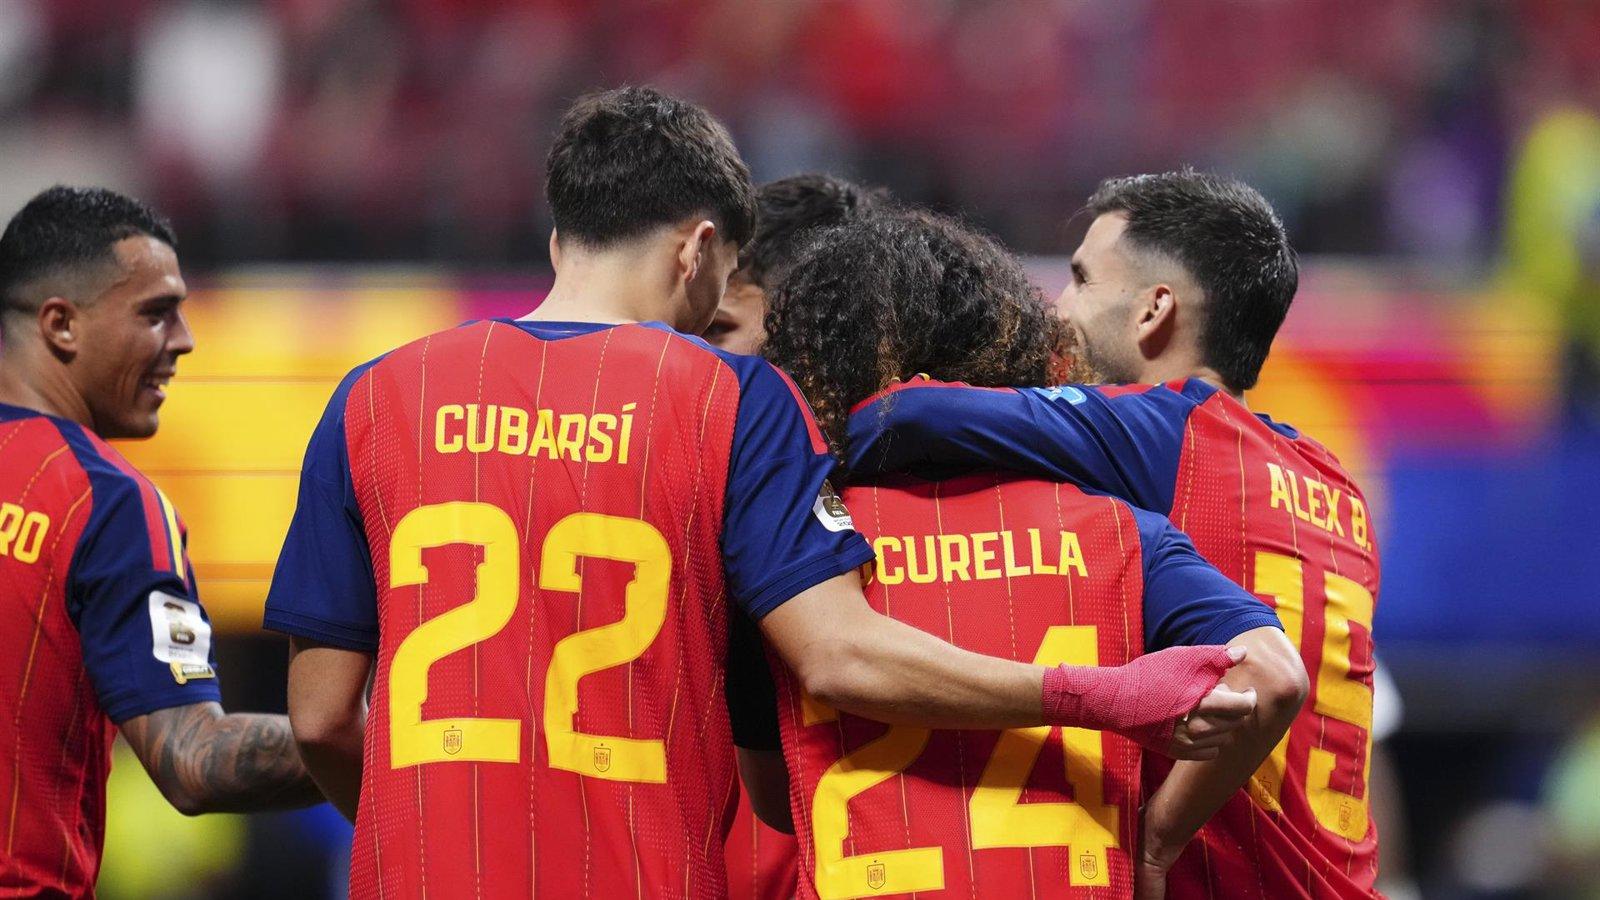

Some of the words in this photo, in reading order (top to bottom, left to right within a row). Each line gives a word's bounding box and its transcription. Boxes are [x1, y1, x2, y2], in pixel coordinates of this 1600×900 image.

[435, 402, 637, 464] CUBARSÍ
[1266, 462, 1345, 538] ALEX
[389, 501, 672, 783] 22
[801, 625, 1120, 900] 24
[1254, 551, 1374, 843] 15
